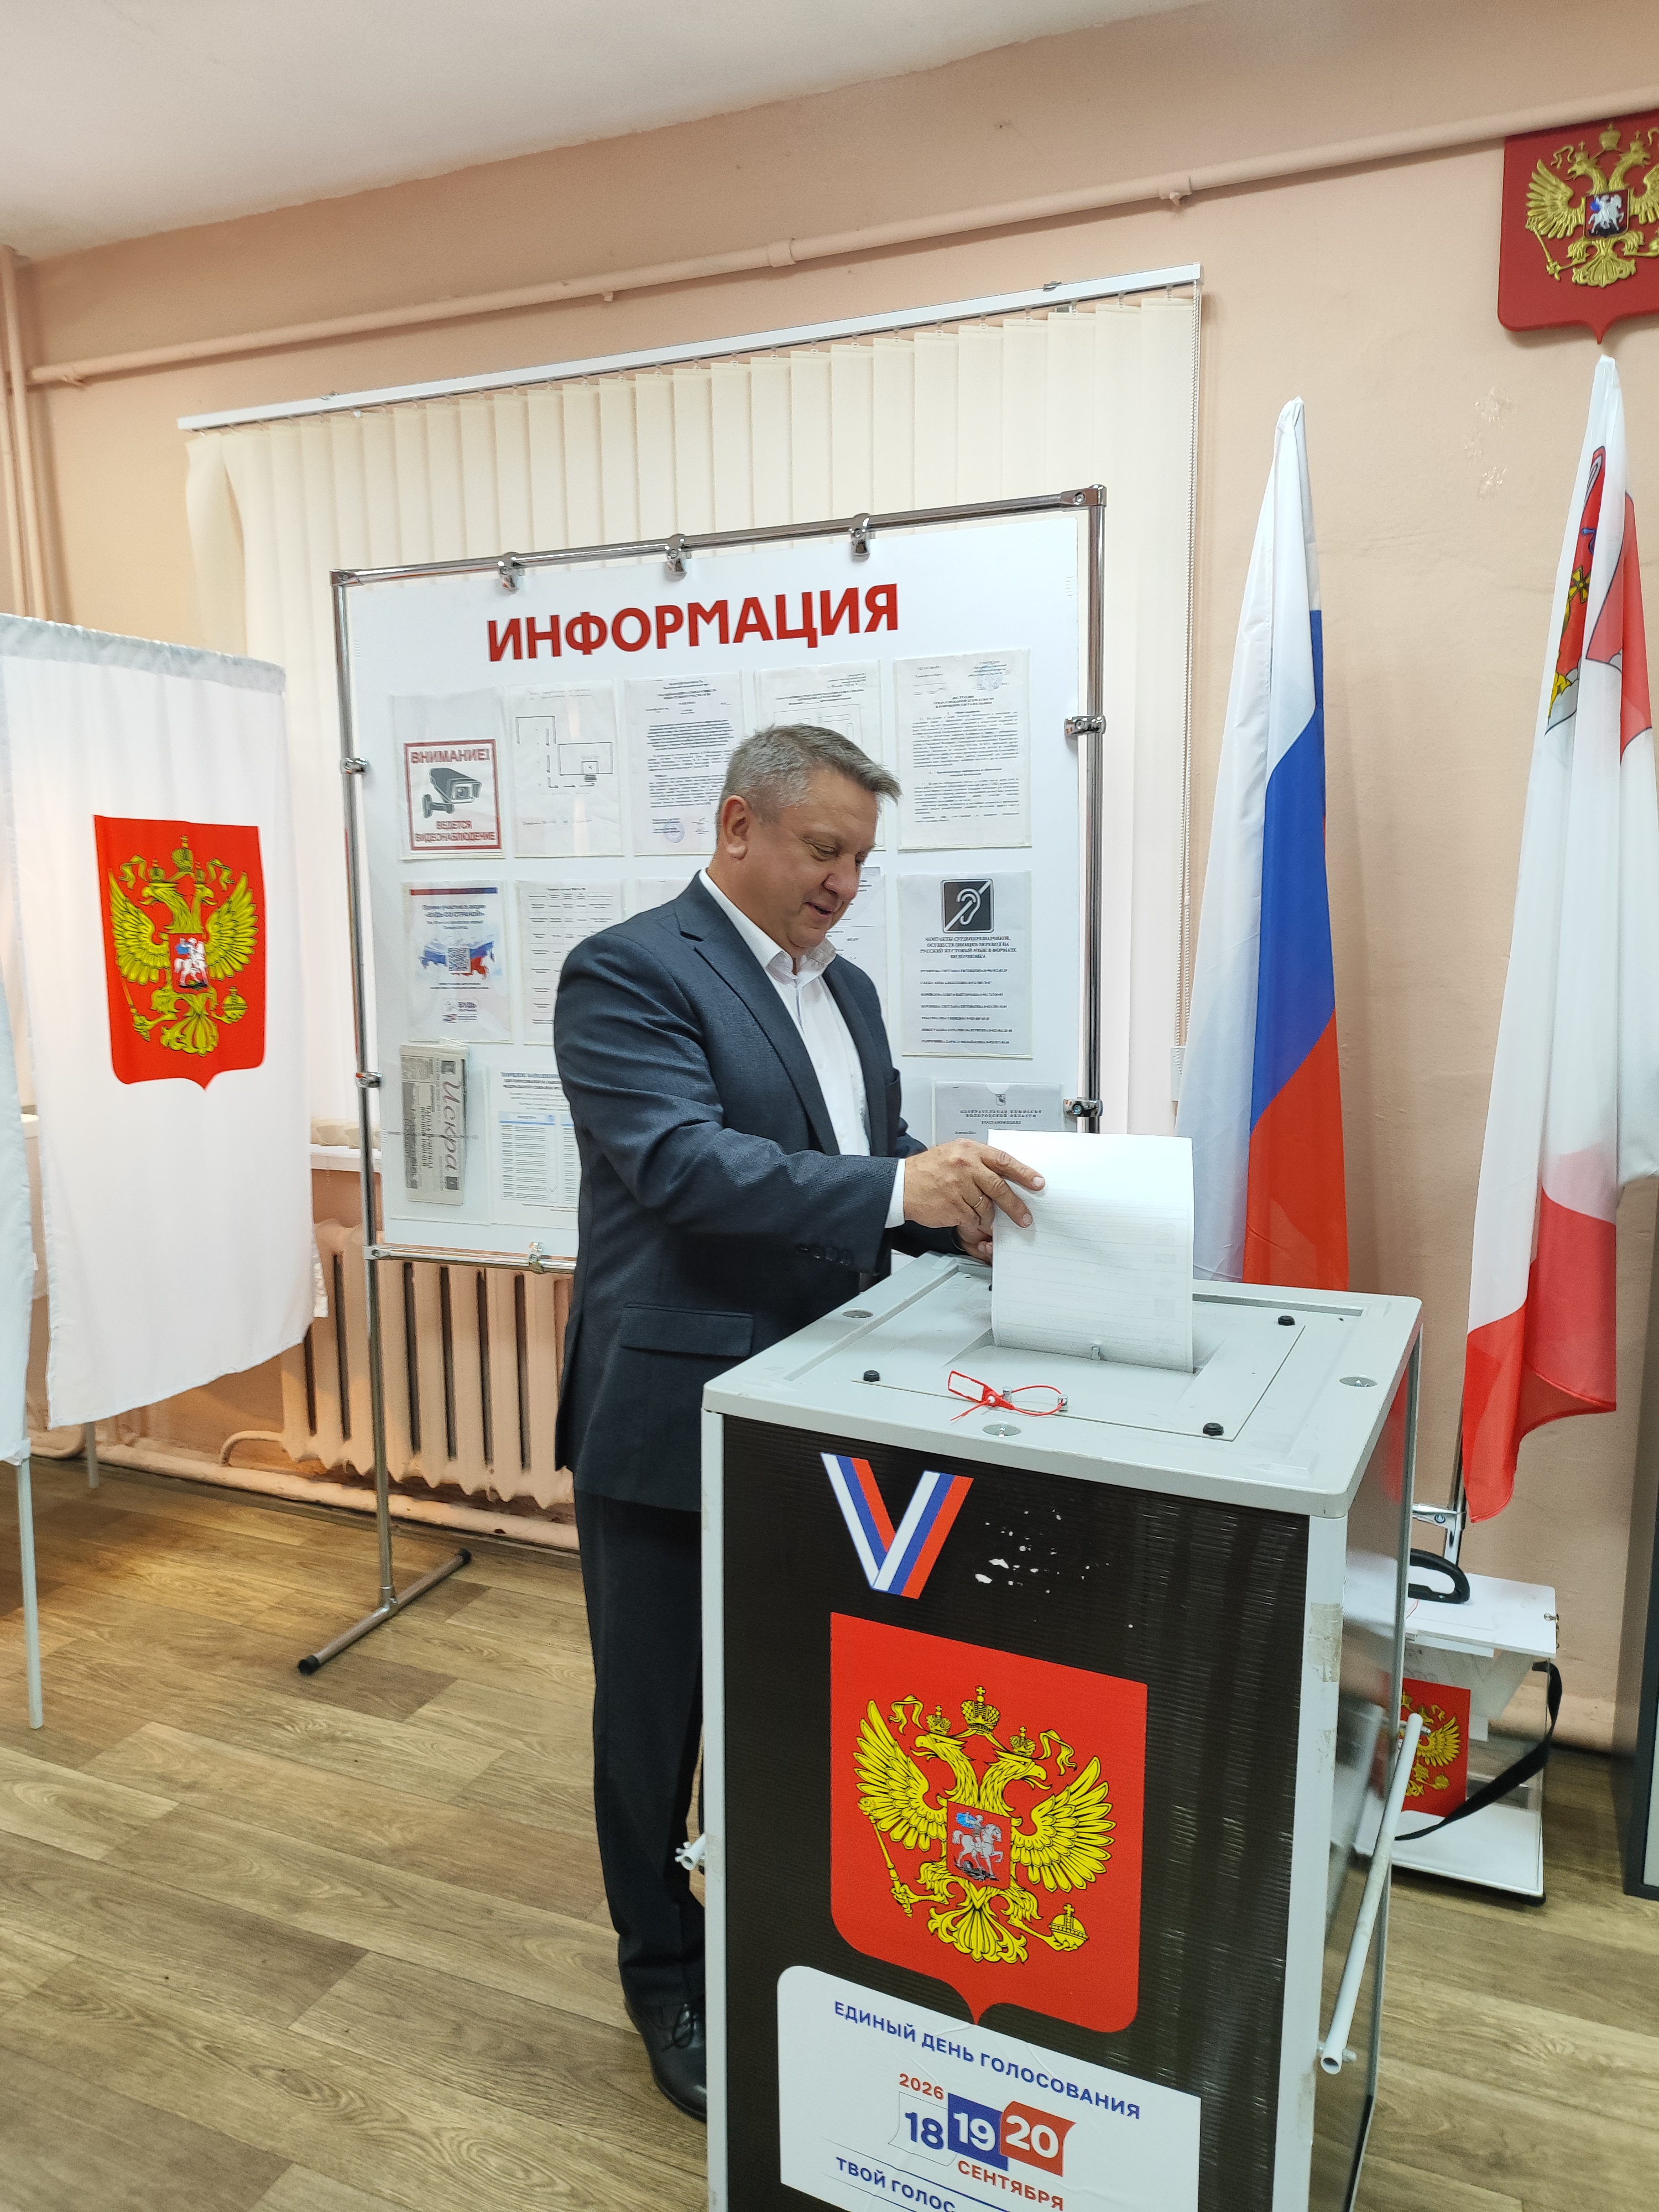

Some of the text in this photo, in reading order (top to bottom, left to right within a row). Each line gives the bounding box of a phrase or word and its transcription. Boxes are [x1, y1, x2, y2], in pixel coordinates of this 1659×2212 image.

[487, 583, 898, 662] ИНФОРМАЦИЯ
[411, 749, 490, 763] ВНИМАНИЕ!
[415, 832, 496, 842] ВИДЕОНАБЛЮДЕНИЕ
[442, 1081, 463, 1171] Искра
[834, 2000, 1141, 2120] ЕДИНЫЙ ДЕНЬ ГОЛОСОВАНИЯ
[899, 2073, 945, 2100] 2026
[905, 2112, 1059, 2158] 18 19 20
[836, 2157, 956, 2212] ТВОЙ ГОЛОС
[958, 2160, 1063, 2211] СЕНТЯБРЯ
